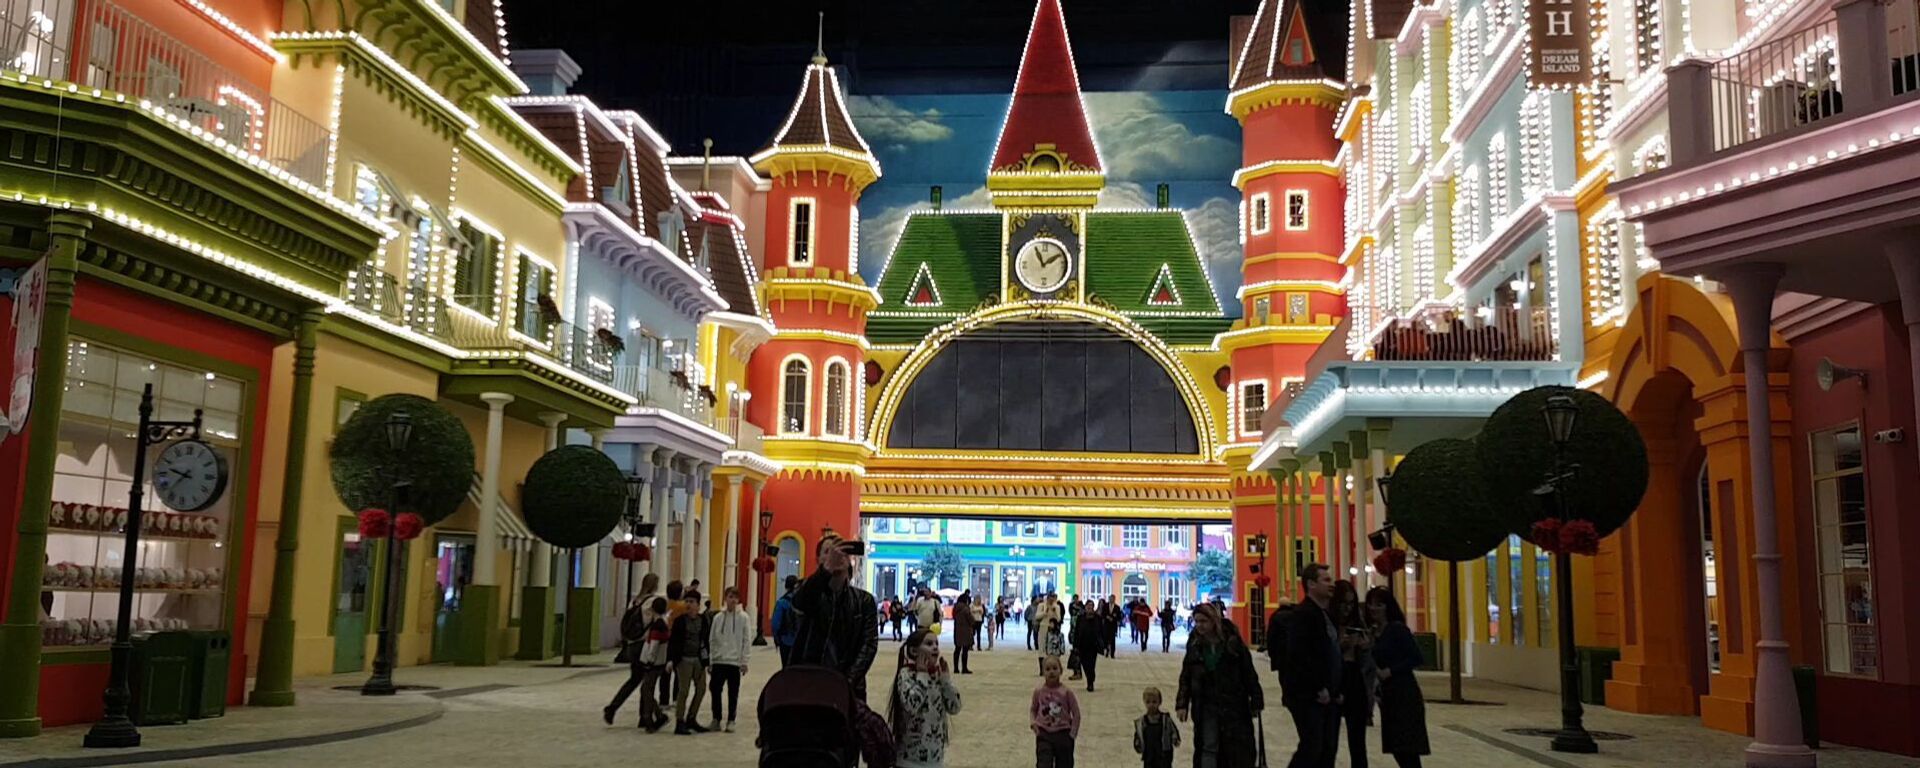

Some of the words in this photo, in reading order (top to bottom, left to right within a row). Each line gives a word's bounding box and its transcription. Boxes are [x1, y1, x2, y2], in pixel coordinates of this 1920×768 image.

[1545, 11, 1574, 36] H
[1542, 56, 1579, 64] DREAM
[1542, 64, 1580, 72] ISLAND
